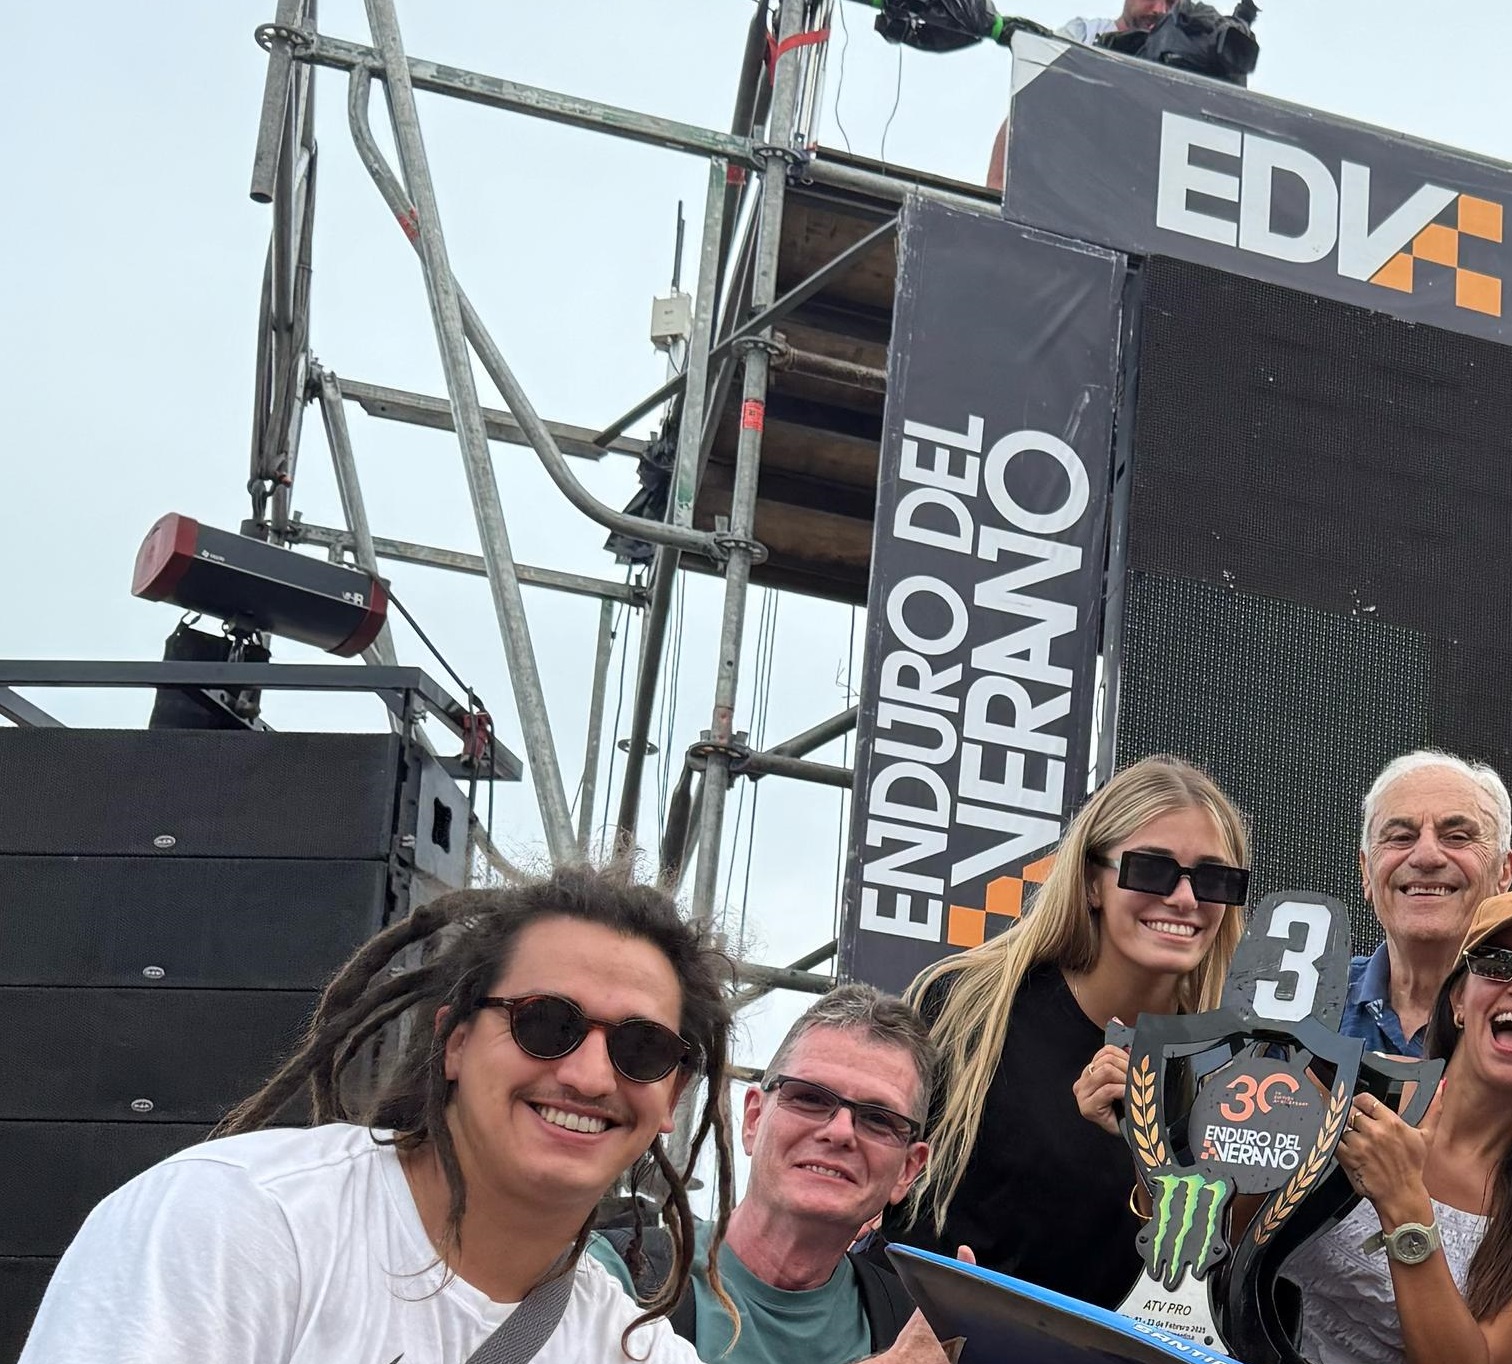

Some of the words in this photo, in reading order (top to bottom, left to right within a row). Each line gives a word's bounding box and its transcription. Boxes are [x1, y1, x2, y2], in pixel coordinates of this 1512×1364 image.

[1156, 110, 1462, 282] EDV
[892, 413, 985, 555] DEL
[950, 429, 1091, 888] VERANO
[860, 574, 969, 943] ENDURO
[1252, 901, 1332, 1022] 3
[1205, 1125, 1271, 1147] ENDURO
[1275, 1133, 1301, 1151] DEL
[1214, 1141, 1300, 1170] VERANO
[1221, 1072, 1300, 1122] 30
[1143, 1300, 1167, 1313] ATV
[1167, 1303, 1192, 1316] PRO
